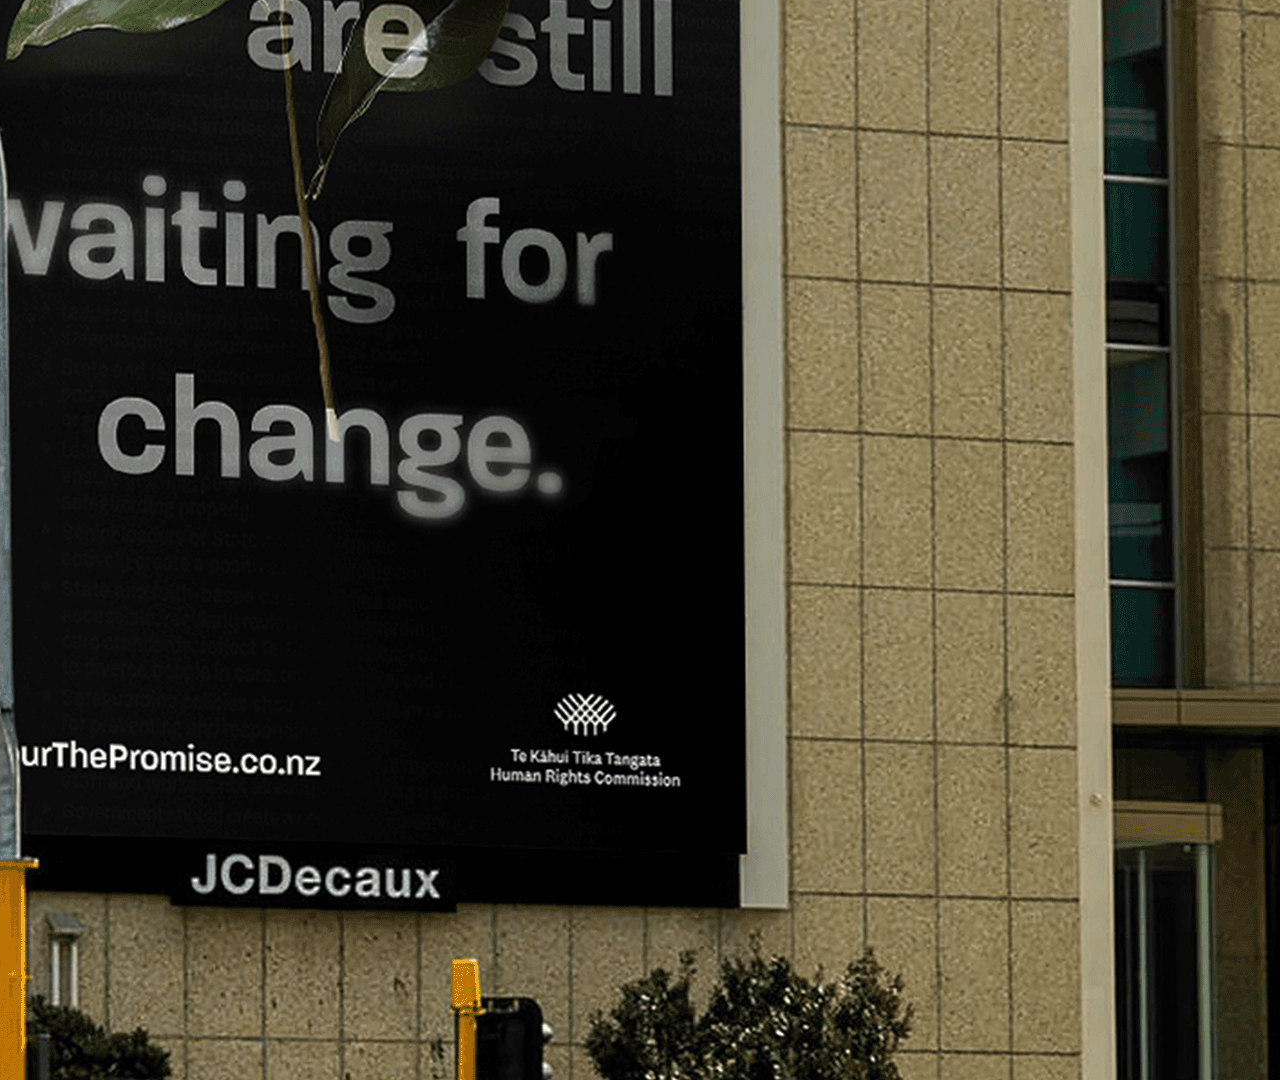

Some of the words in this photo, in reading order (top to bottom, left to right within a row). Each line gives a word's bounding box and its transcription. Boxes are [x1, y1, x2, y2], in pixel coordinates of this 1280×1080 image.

[457, 198, 614, 306] for
[97, 373, 563, 519] change.
[490, 767, 541, 782] Human
[545, 768, 591, 786] Rights
[593, 770, 681, 787] Commission
[510, 748, 528, 763] Te
[572, 750, 603, 765] Tika
[605, 752, 661, 771] Tangata
[190, 854, 441, 899] JCDecaux
